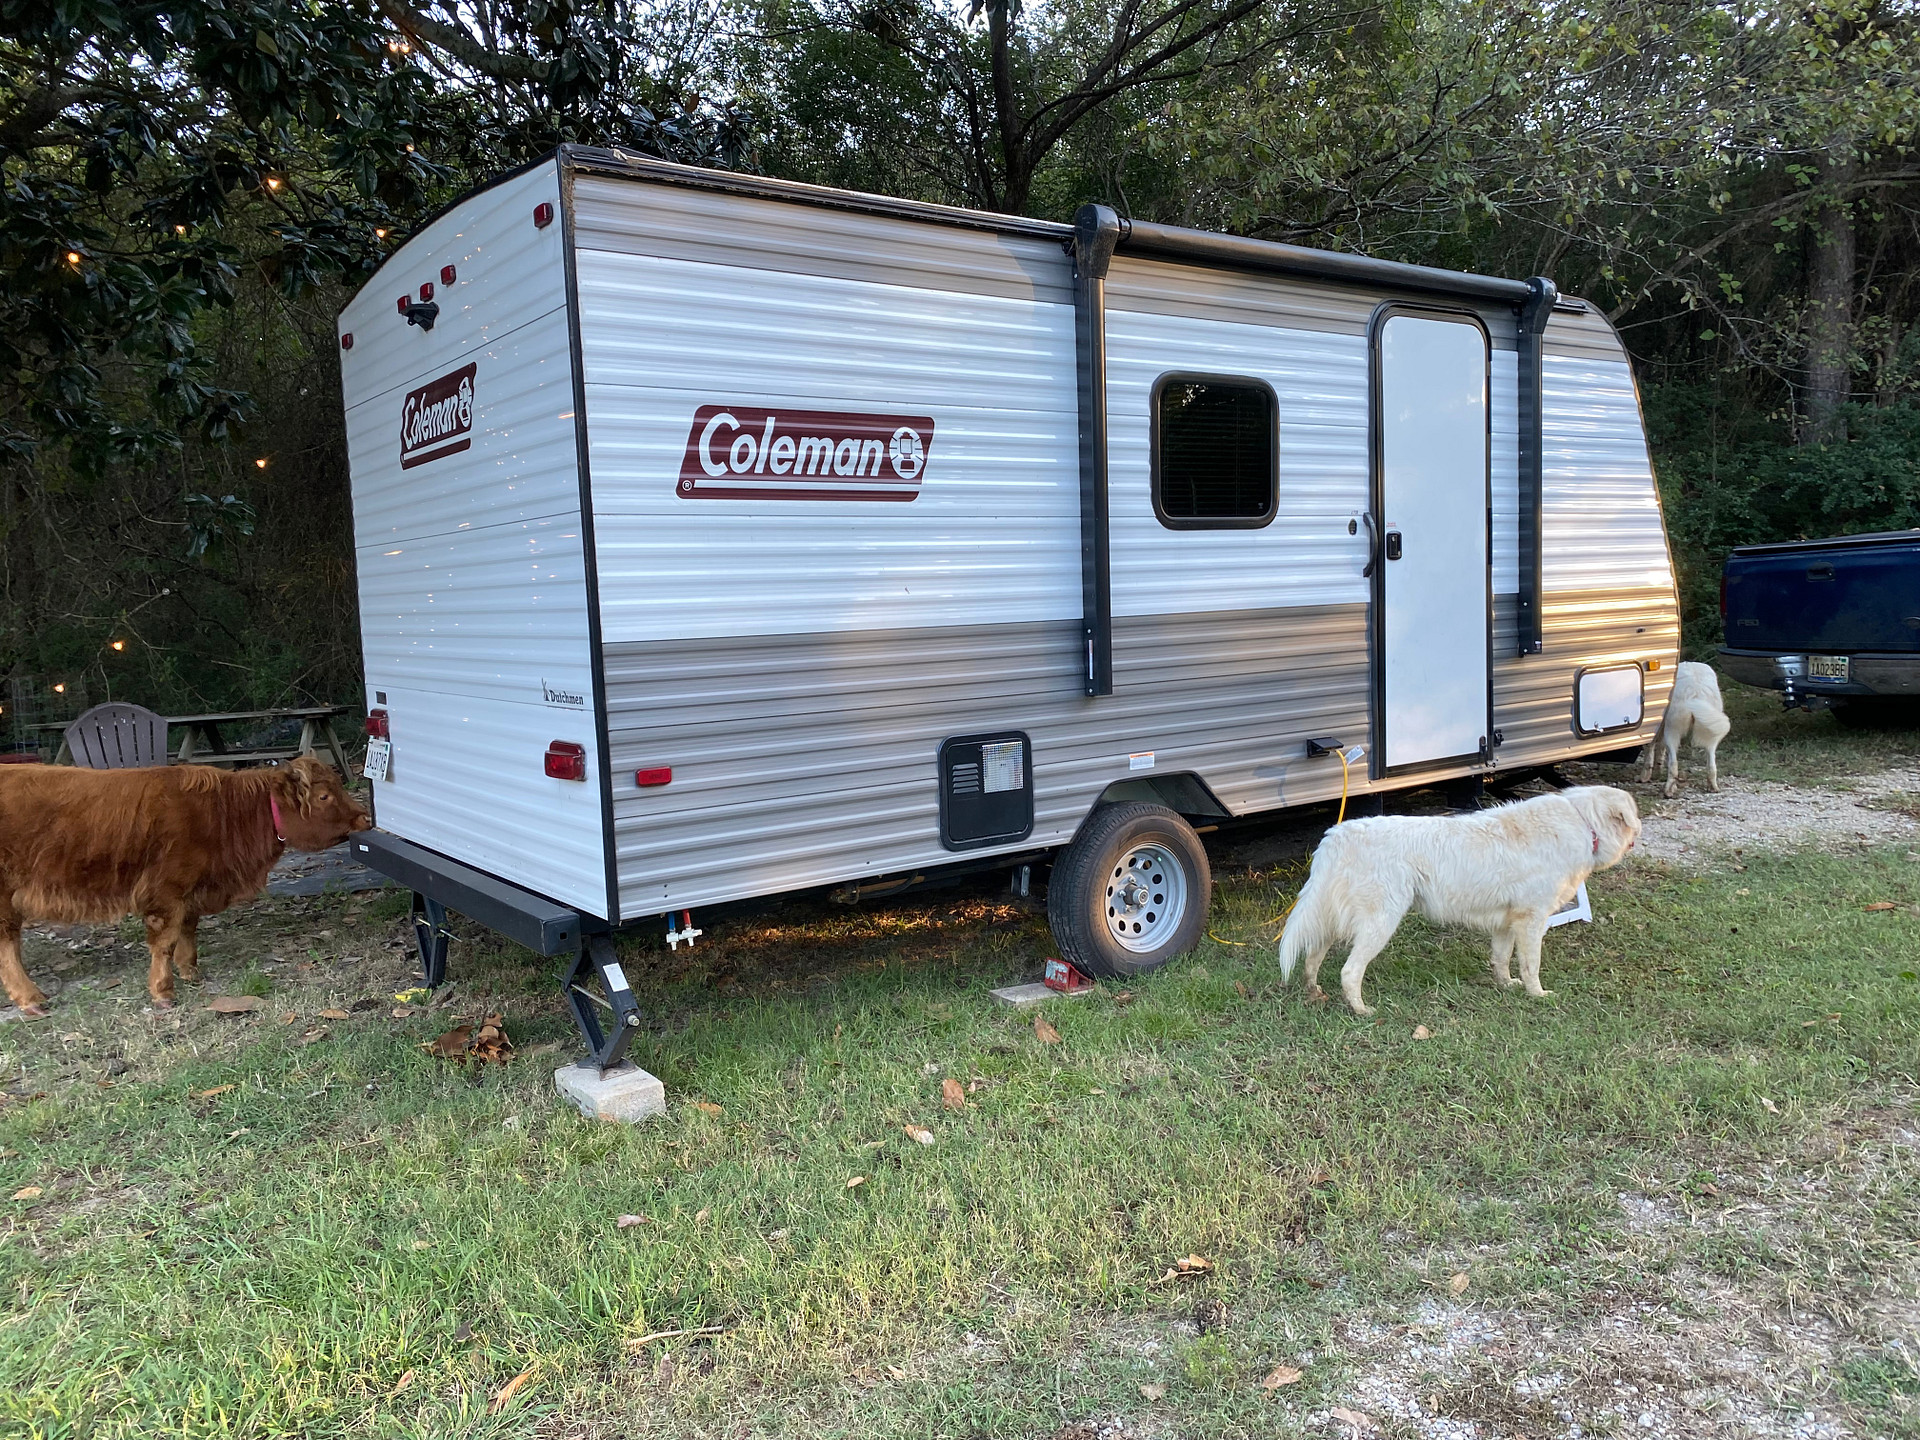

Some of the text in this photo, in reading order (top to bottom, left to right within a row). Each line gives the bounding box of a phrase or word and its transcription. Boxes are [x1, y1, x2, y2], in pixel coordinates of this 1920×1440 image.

[403, 392, 458, 450] Coleman
[698, 412, 884, 477] Coleman
[550, 690, 584, 705] Dutchmen
